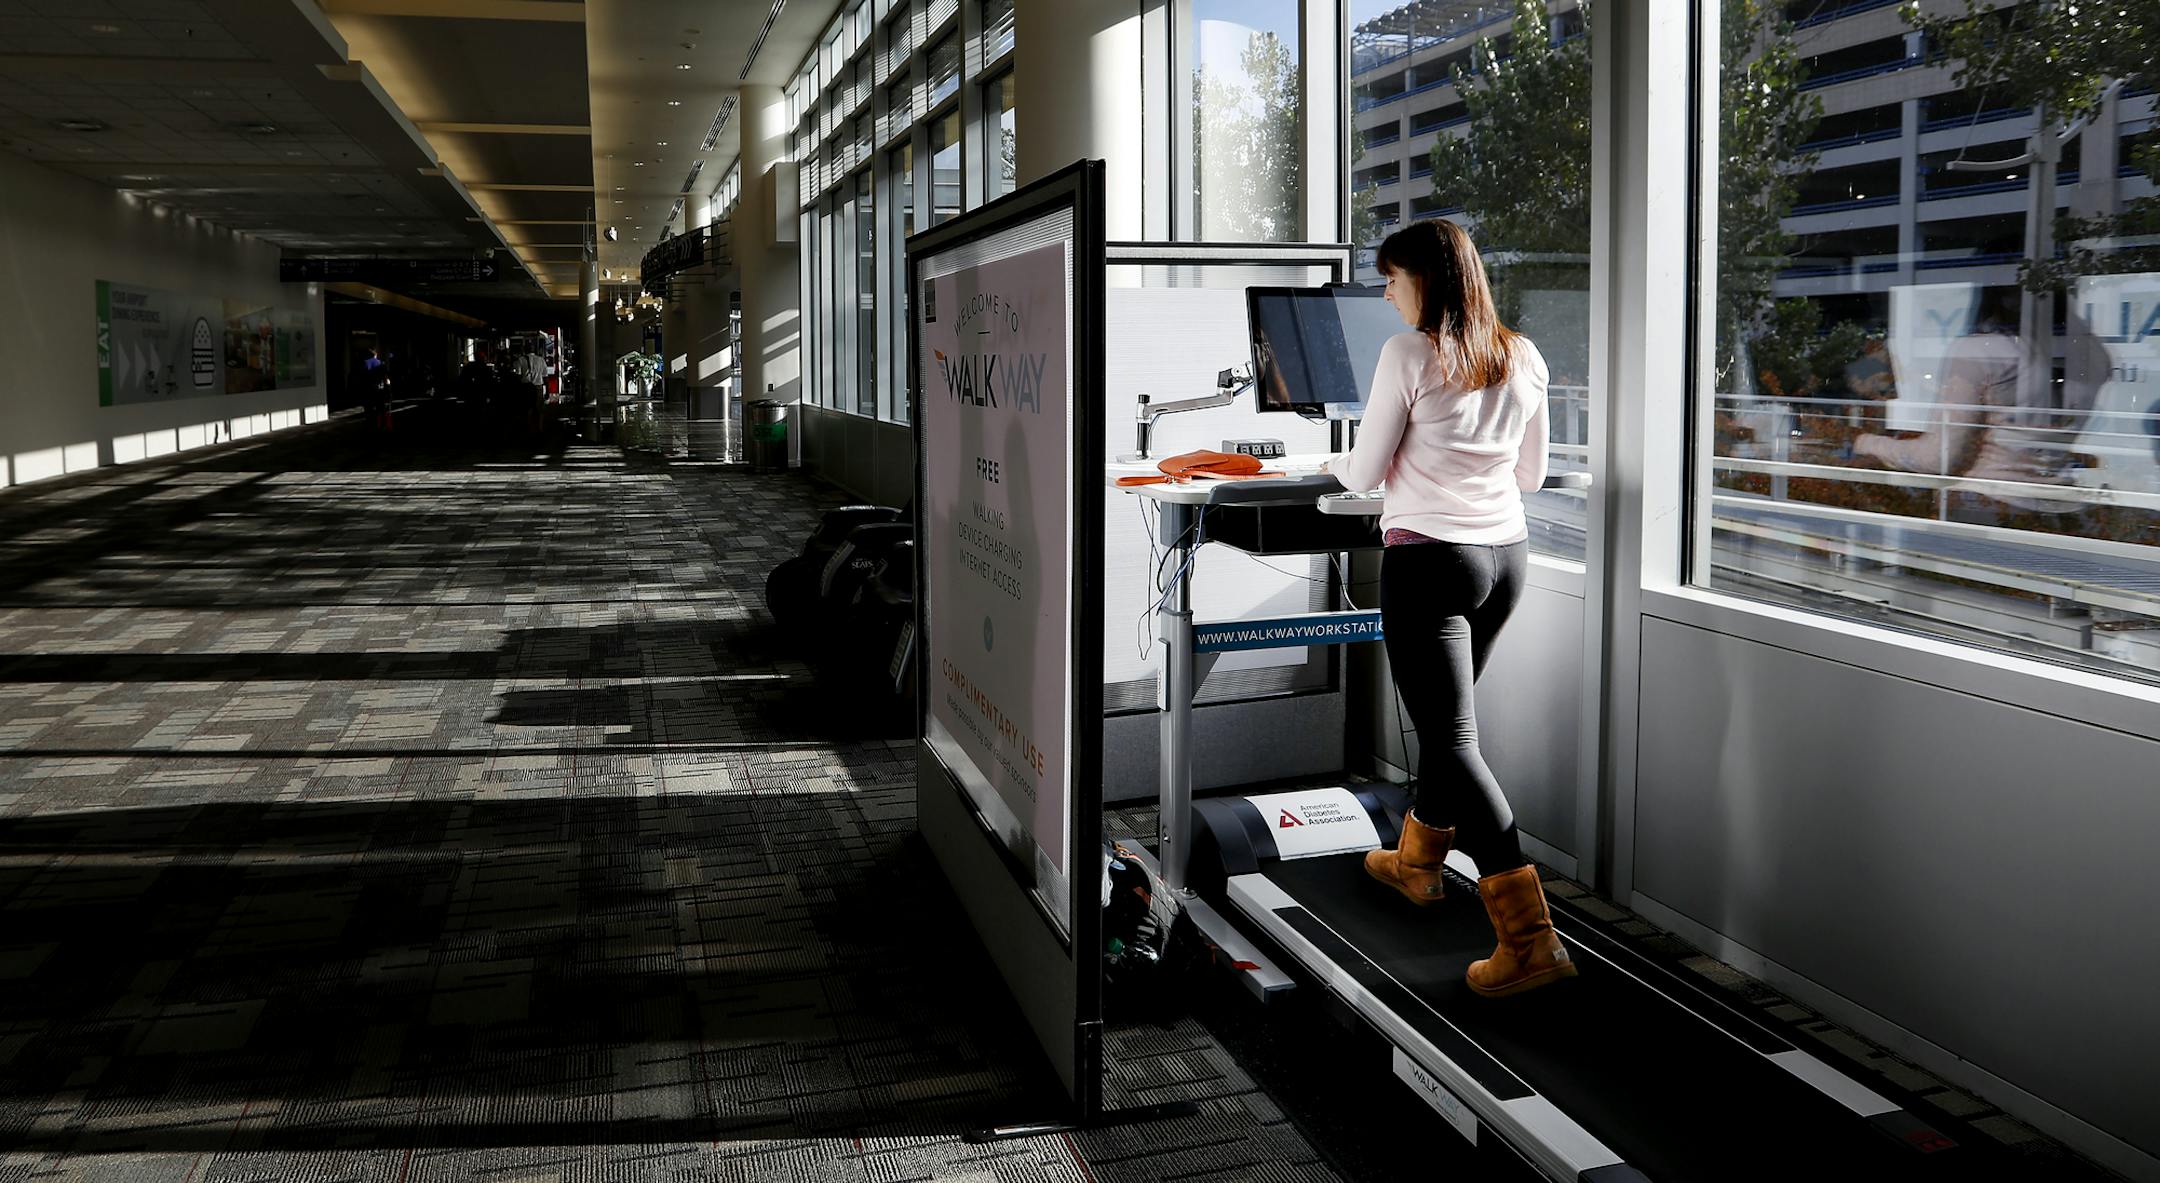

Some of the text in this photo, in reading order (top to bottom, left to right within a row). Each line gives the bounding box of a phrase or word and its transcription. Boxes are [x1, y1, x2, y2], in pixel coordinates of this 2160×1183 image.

[953, 293, 1019, 337] WELCOME TO
[97, 316, 110, 368] EAT
[976, 457, 1000, 484] FREE
[972, 500, 1004, 530] WALKING
[959, 522, 1023, 570] DEVICE CHARGING
[960, 548, 1021, 600] INTERNET ACCESS
[942, 658, 1044, 777] COMPLIMENTARY USE
[1300, 803, 1340, 811] American
[1303, 809, 1341, 818] Diabetes
